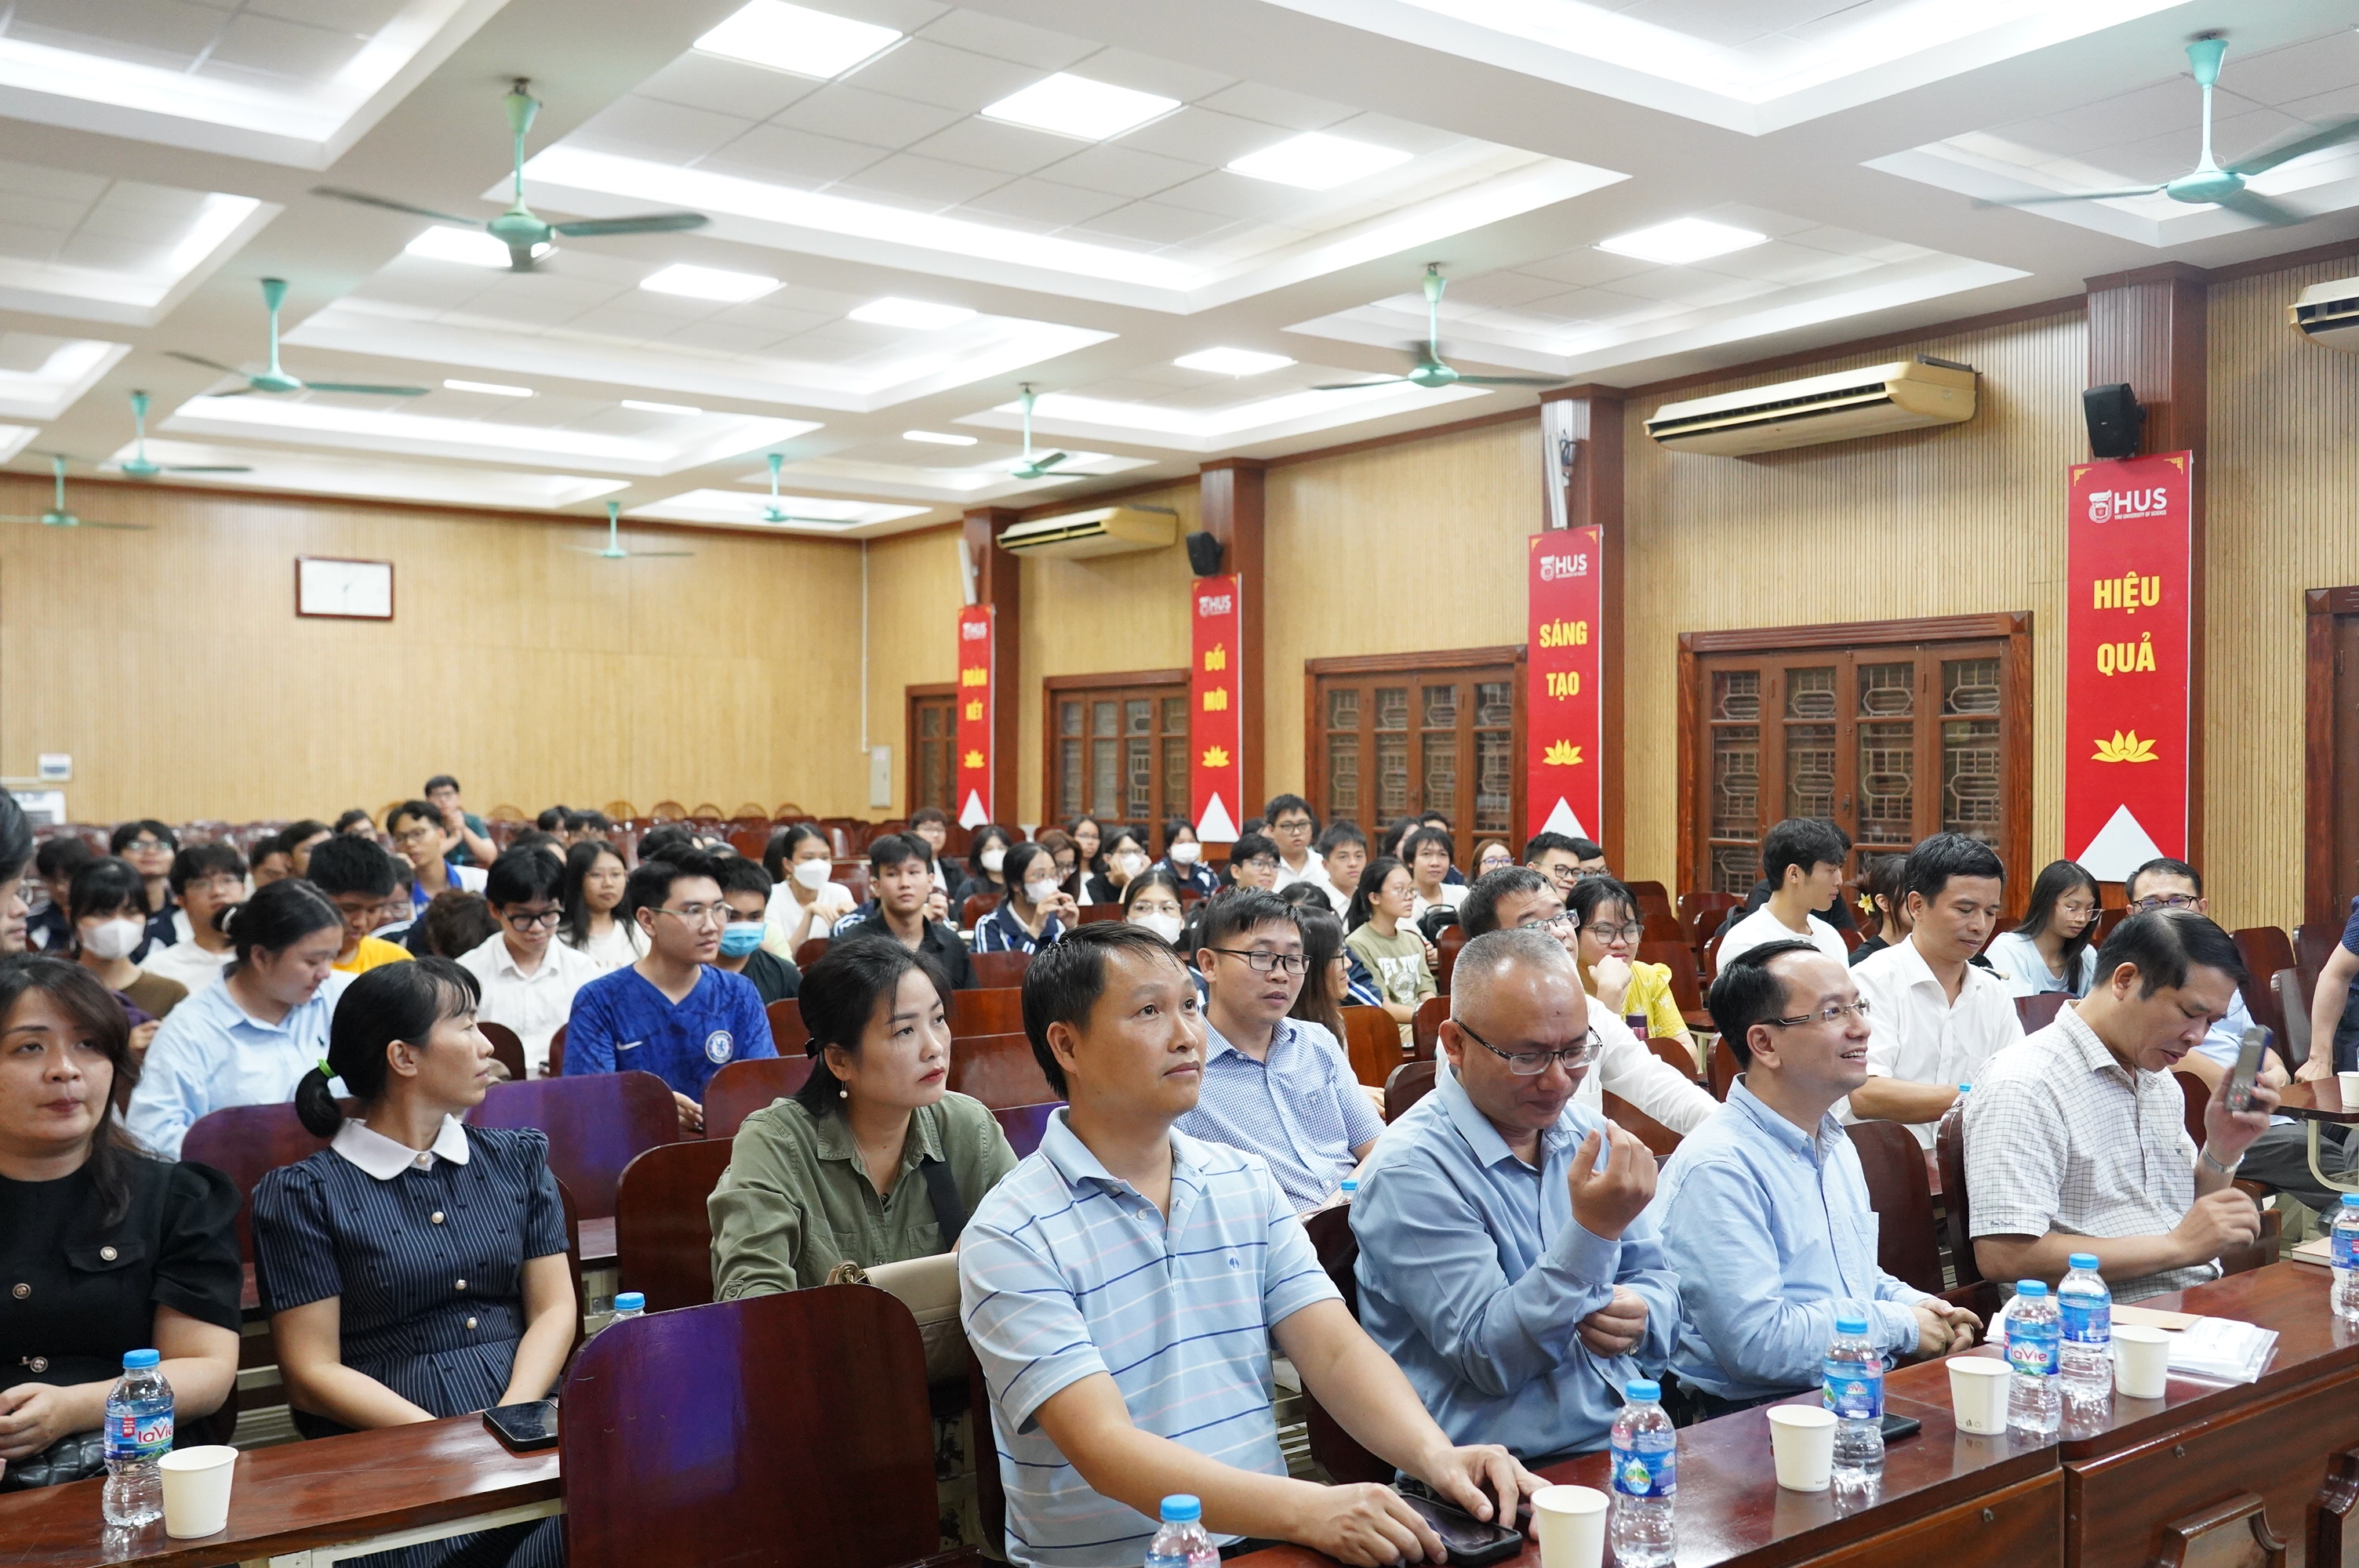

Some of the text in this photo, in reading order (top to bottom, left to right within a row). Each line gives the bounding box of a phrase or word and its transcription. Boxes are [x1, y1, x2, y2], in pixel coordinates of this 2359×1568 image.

[2114, 488, 2167, 514] HUS
[1556, 554, 1587, 574] HUS
[1209, 595, 1231, 612] HUS
[2093, 572, 2160, 614] HIỆU
[1539, 619, 1588, 648] SÁNG
[2096, 632, 2156, 677] QUẢ
[1546, 671, 1579, 701] TẠO
[2010, 1346, 2048, 1362] laVie
[138, 1424, 173, 1443] laVie
